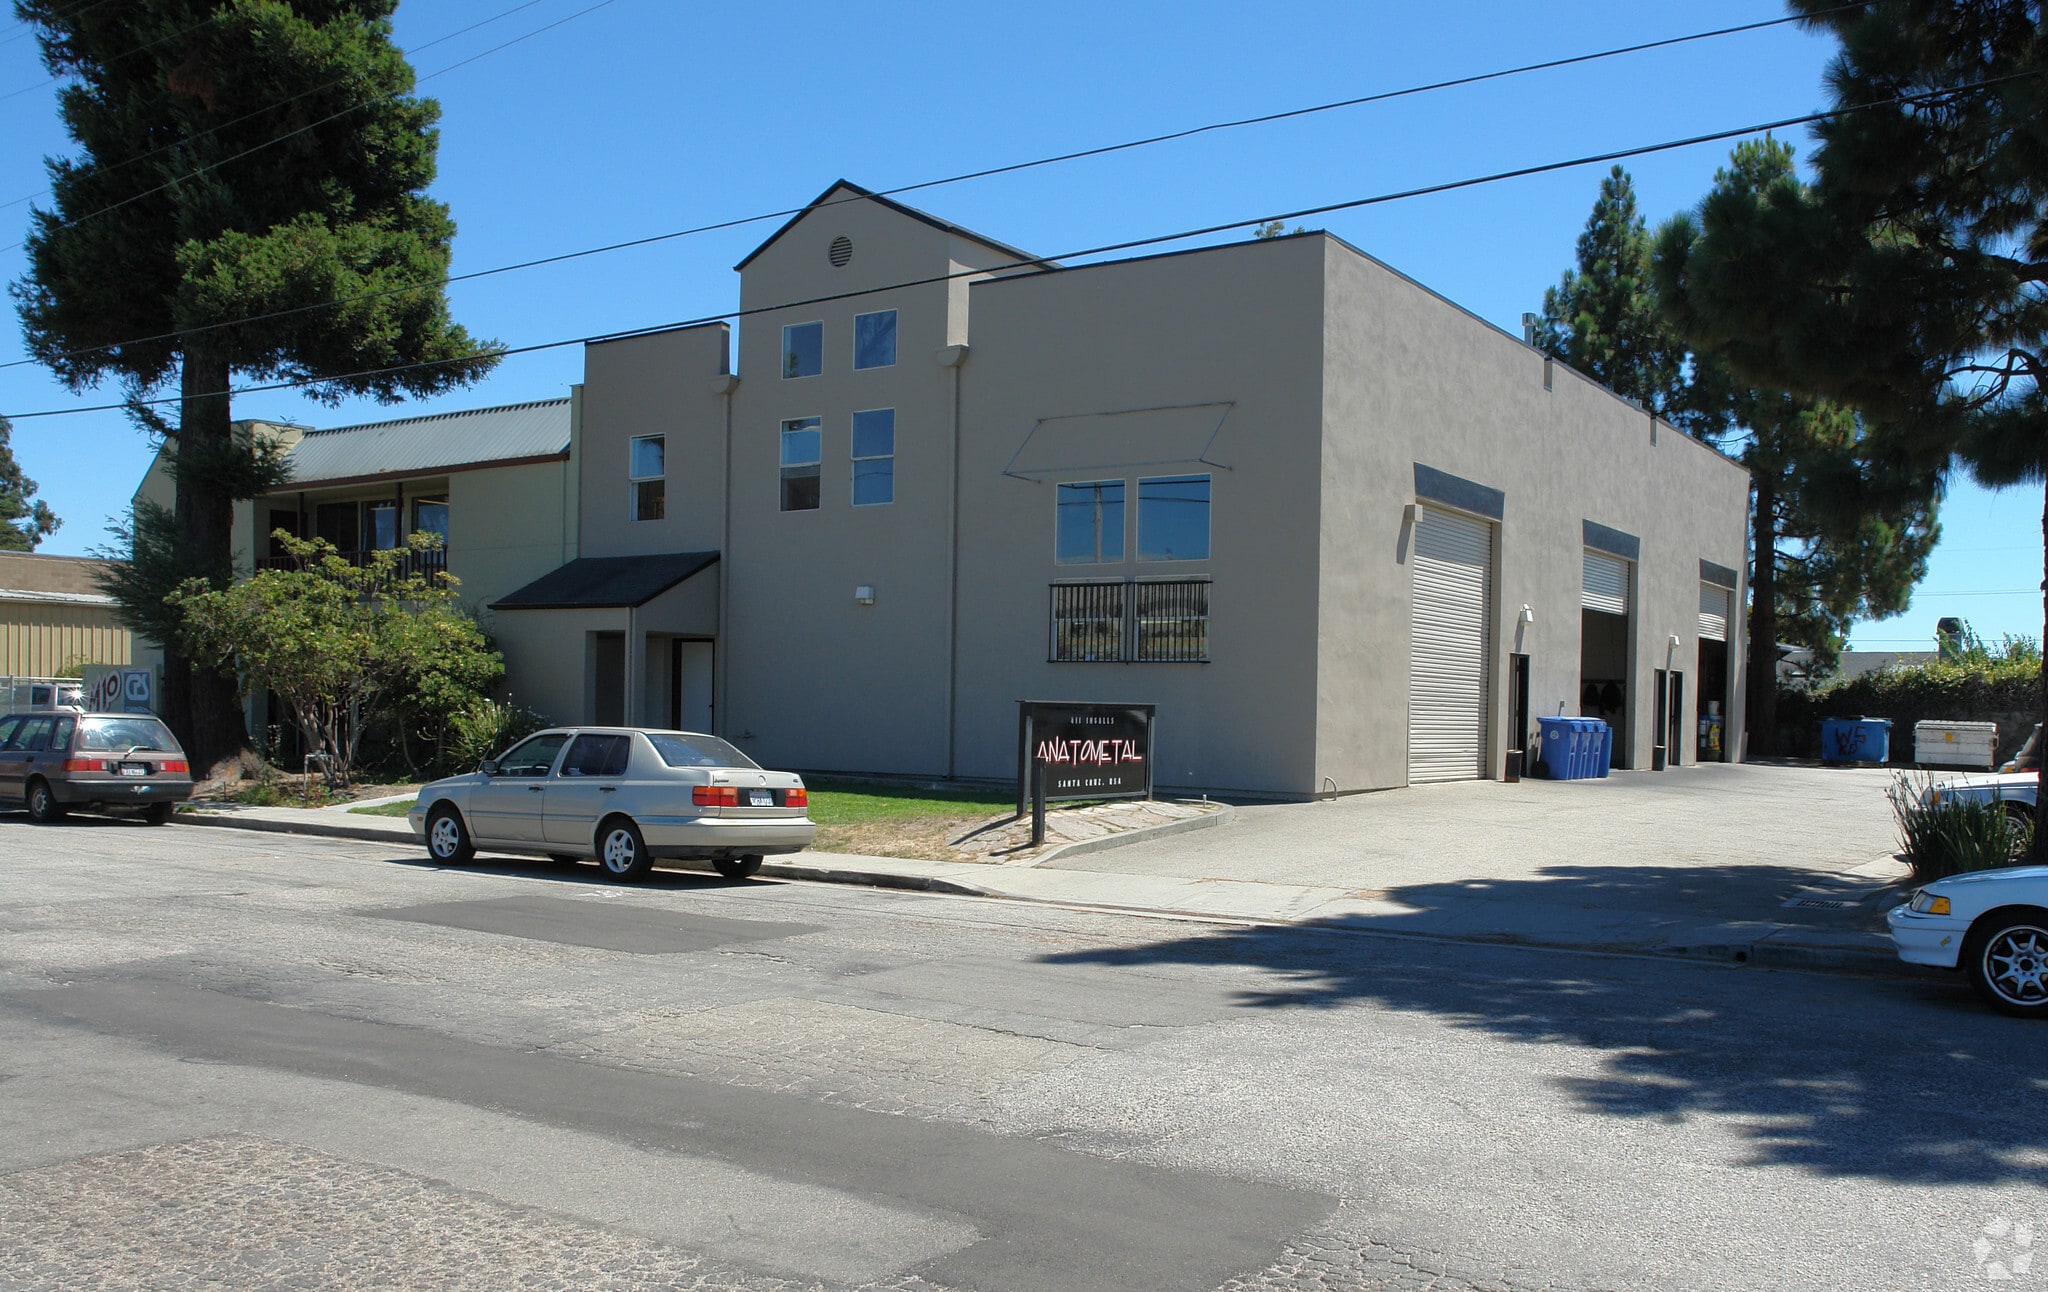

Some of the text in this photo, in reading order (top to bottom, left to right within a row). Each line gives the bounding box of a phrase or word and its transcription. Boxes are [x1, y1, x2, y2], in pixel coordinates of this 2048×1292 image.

[1085, 716, 1115, 725] INGALLS
[1037, 736, 1143, 767] ANATOMETAL
[1058, 779, 1081, 788] SANTA
[1108, 777, 1121, 785] USA
